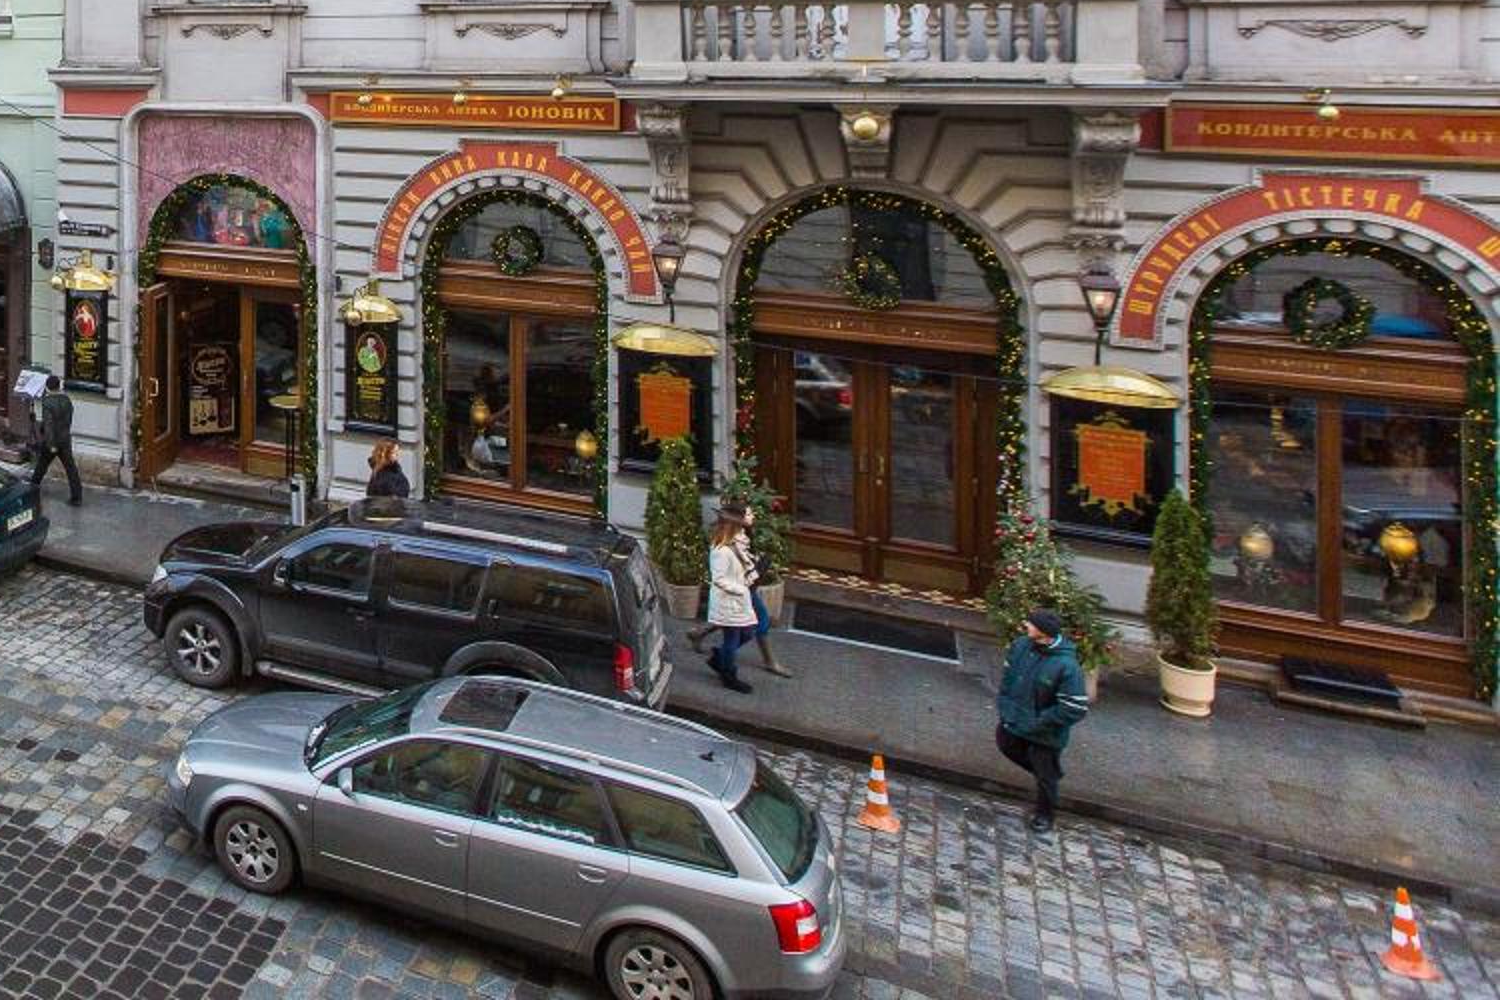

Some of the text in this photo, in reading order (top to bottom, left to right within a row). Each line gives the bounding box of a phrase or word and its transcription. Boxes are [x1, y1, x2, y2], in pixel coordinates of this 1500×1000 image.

[507, 105, 606, 121] ІОНОВИХ
[1197, 121, 1418, 142] КОНДИТЕРСЬКА
[497, 151, 547, 173] КАВА
[568, 169, 626, 221] КАКАО
[1262, 184, 1425, 221] ТІСТЕЧКА
